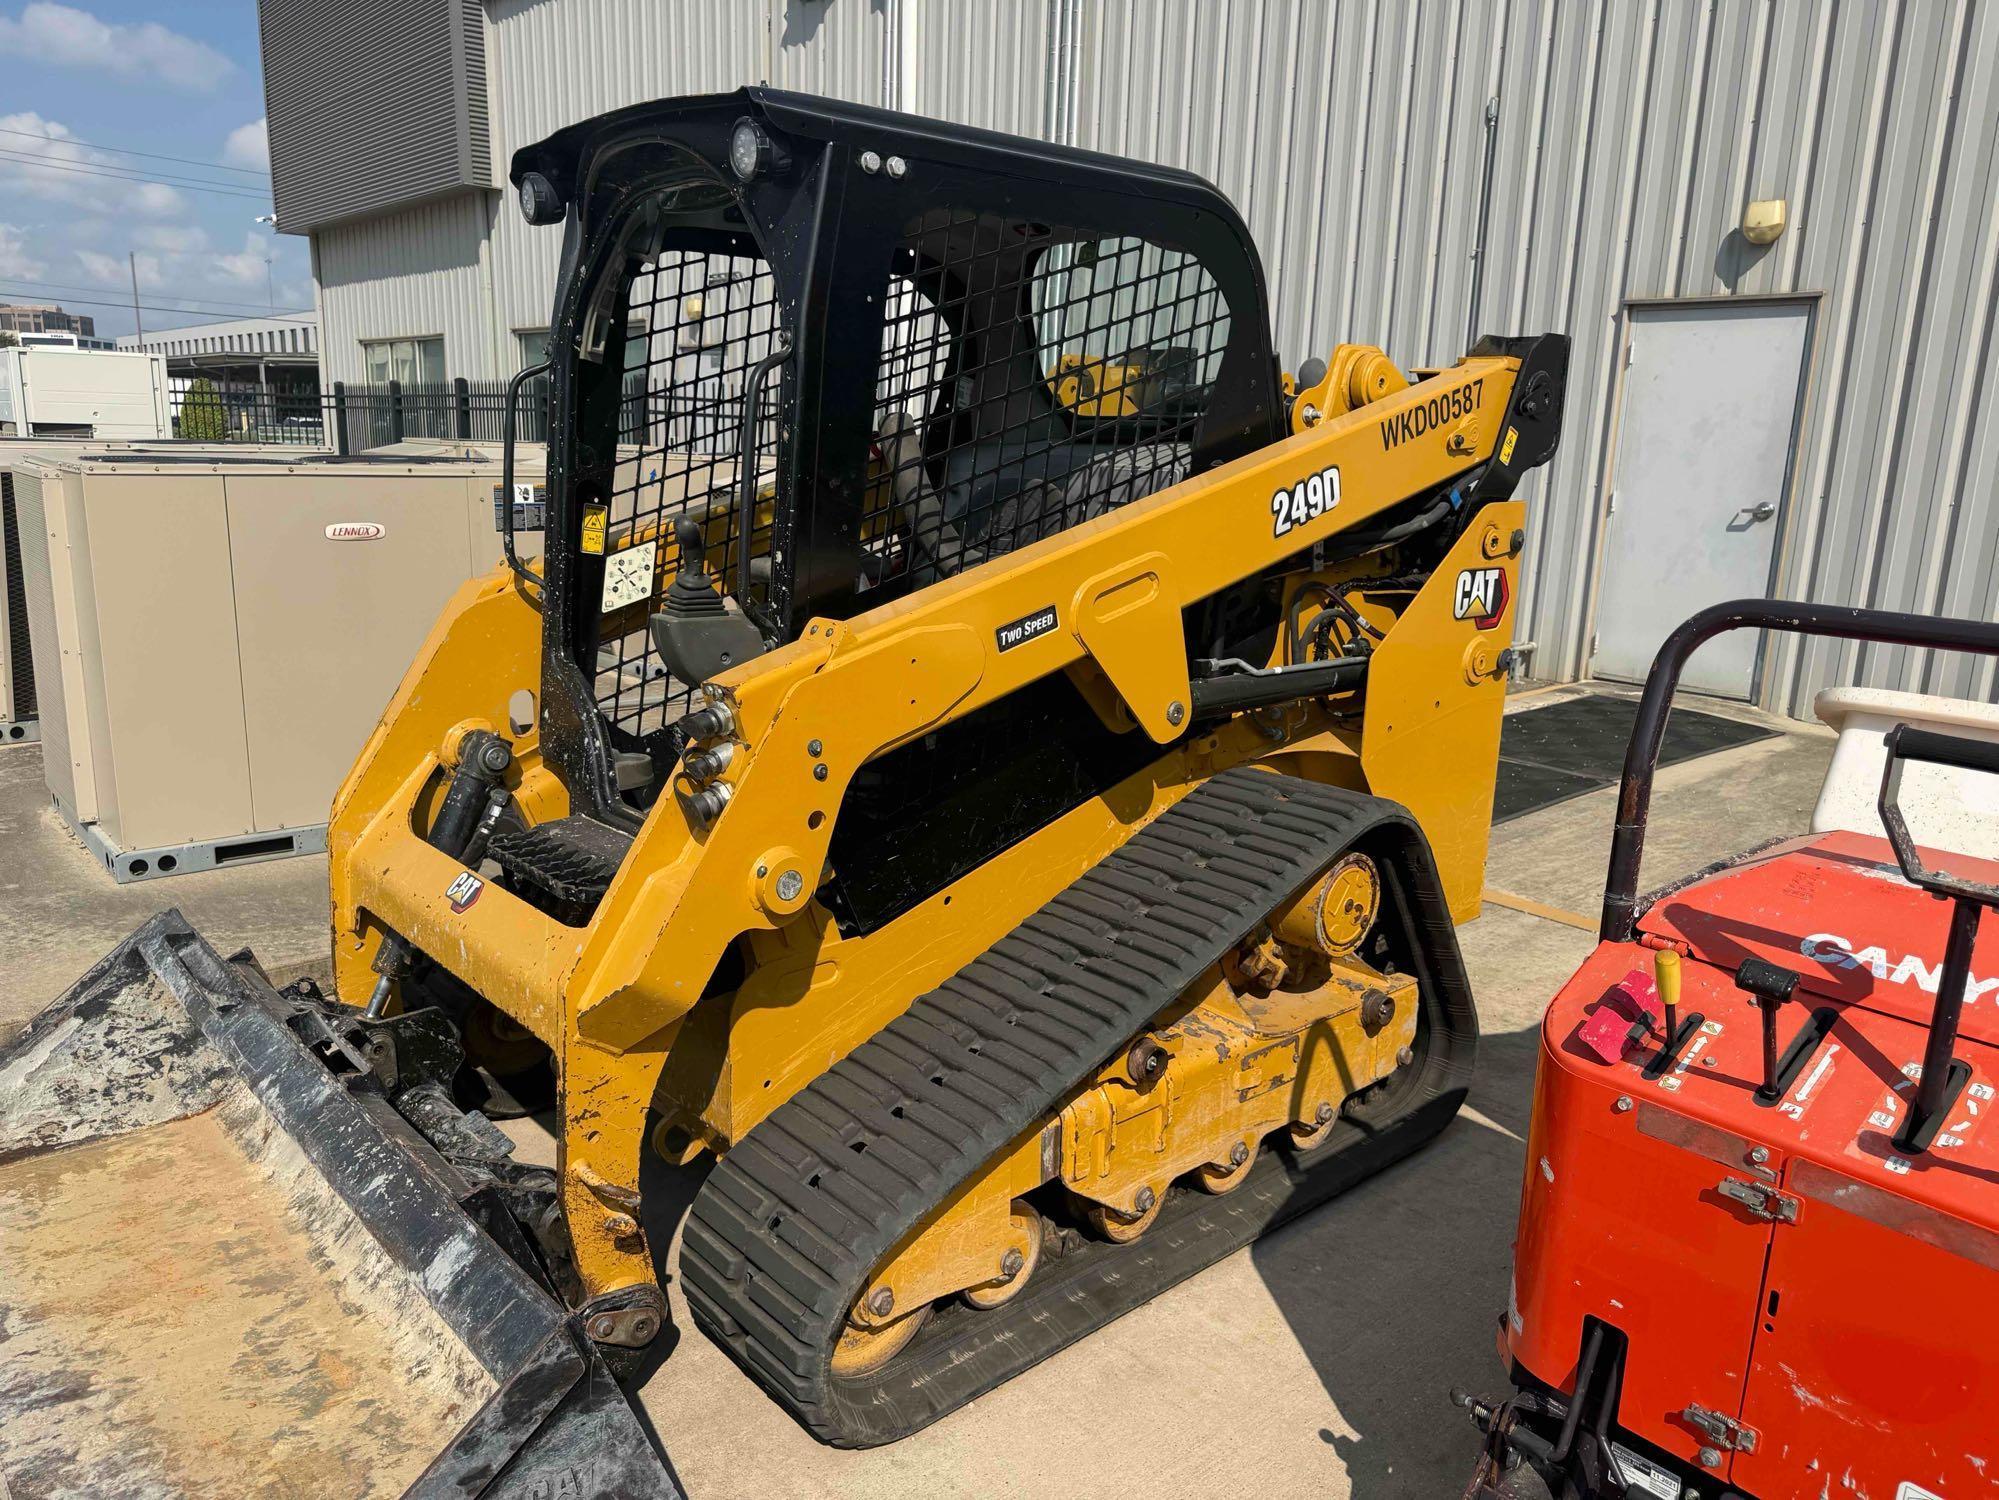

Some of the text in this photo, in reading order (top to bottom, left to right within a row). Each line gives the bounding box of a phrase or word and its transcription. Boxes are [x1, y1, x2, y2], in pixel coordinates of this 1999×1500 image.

[1381, 379, 1484, 451] WKD00587
[332, 526, 371, 537] LENNOX
[1273, 466, 1341, 537] 249D
[1454, 569, 1500, 619] CAT
[446, 871, 482, 905] CAT
[1800, 933, 1999, 1006] CANY
